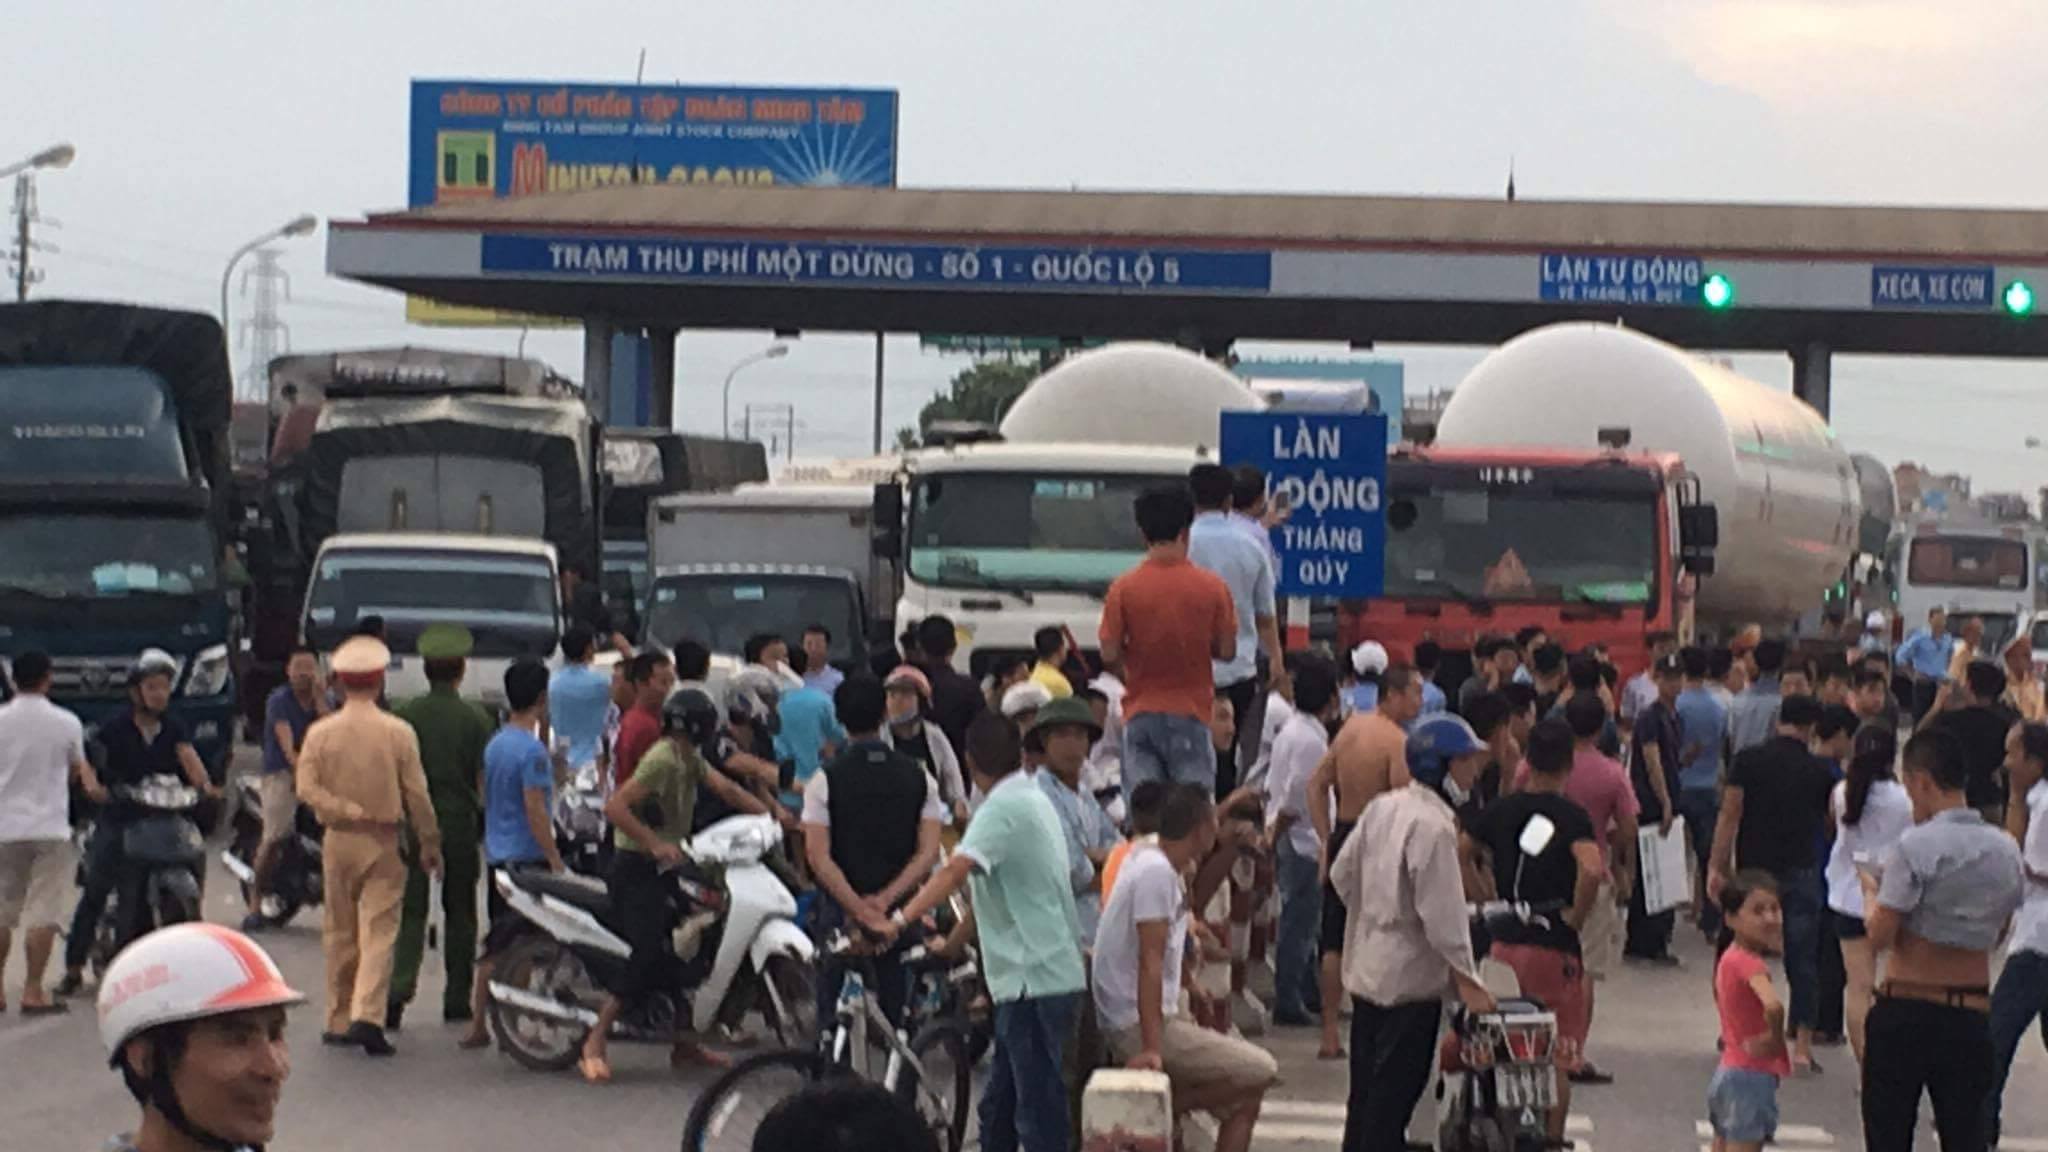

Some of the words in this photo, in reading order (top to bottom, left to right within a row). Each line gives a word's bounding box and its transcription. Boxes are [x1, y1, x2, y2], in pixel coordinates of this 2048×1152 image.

[549, 244, 628, 275] TRẠM
[638, 245, 693, 273] THU
[703, 243, 749, 273] PHÍ
[757, 243, 821, 281] MỘT
[940, 246, 981, 279] SỐ
[992, 257, 1003, 280] 1
[1031, 244, 1112, 283] QUỐC
[1117, 251, 1155, 288] LỘ
[1273, 417, 1341, 460] LÀN
[1283, 520, 1364, 554] THÁNG
